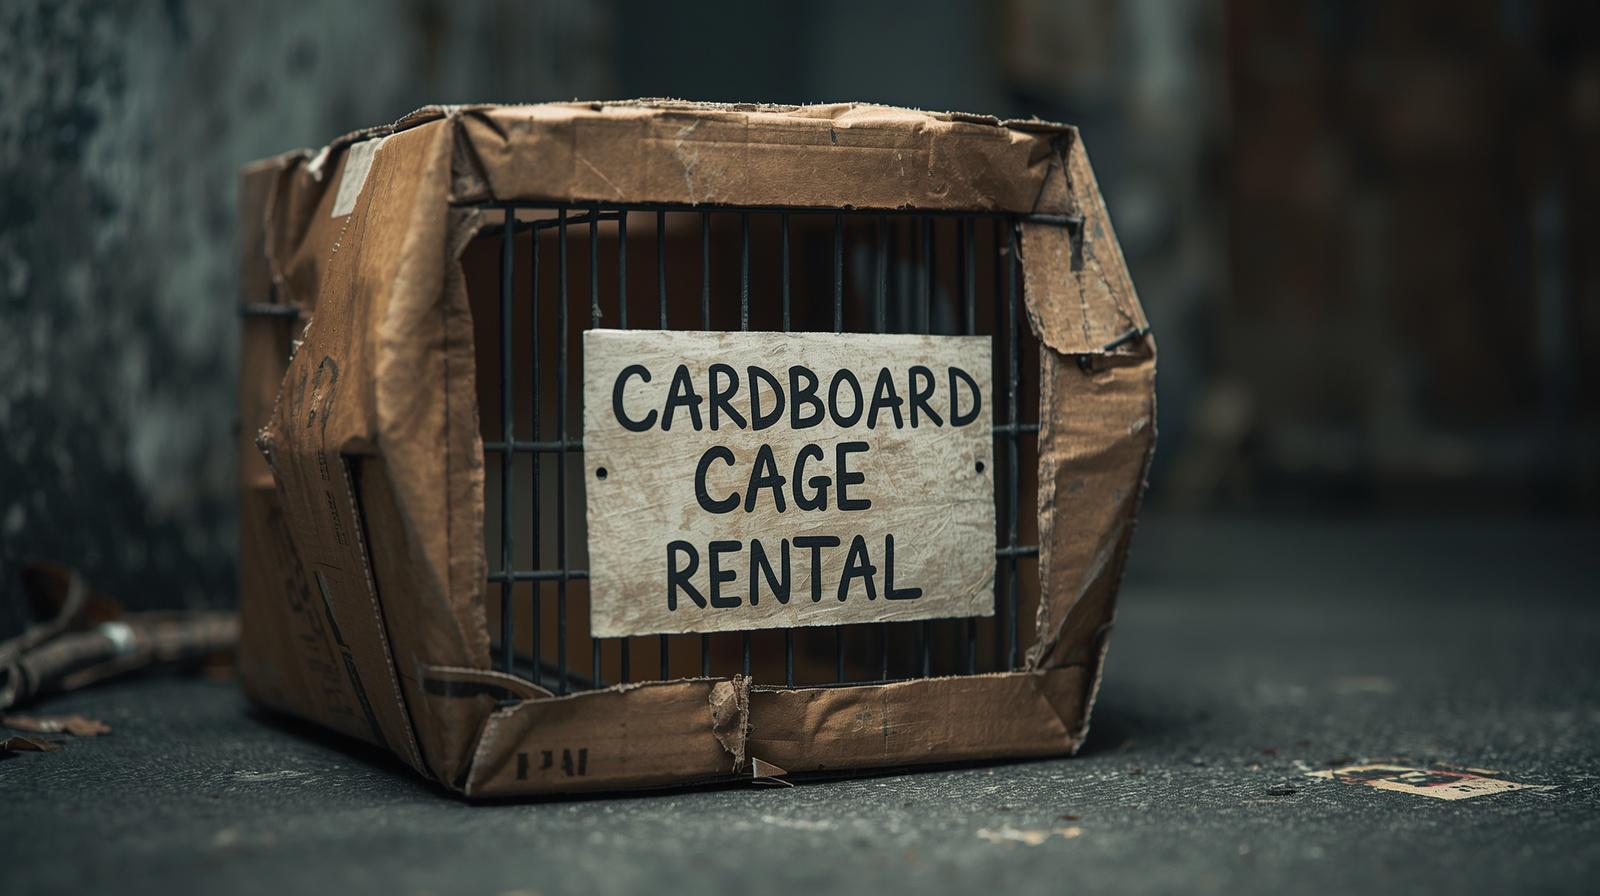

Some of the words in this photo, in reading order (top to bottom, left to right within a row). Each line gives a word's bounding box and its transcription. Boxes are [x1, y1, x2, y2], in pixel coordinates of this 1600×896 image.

[613, 364, 981, 432] CARDBOARD
[695, 442, 871, 514] CAGE
[667, 534, 922, 611] RENTAL
